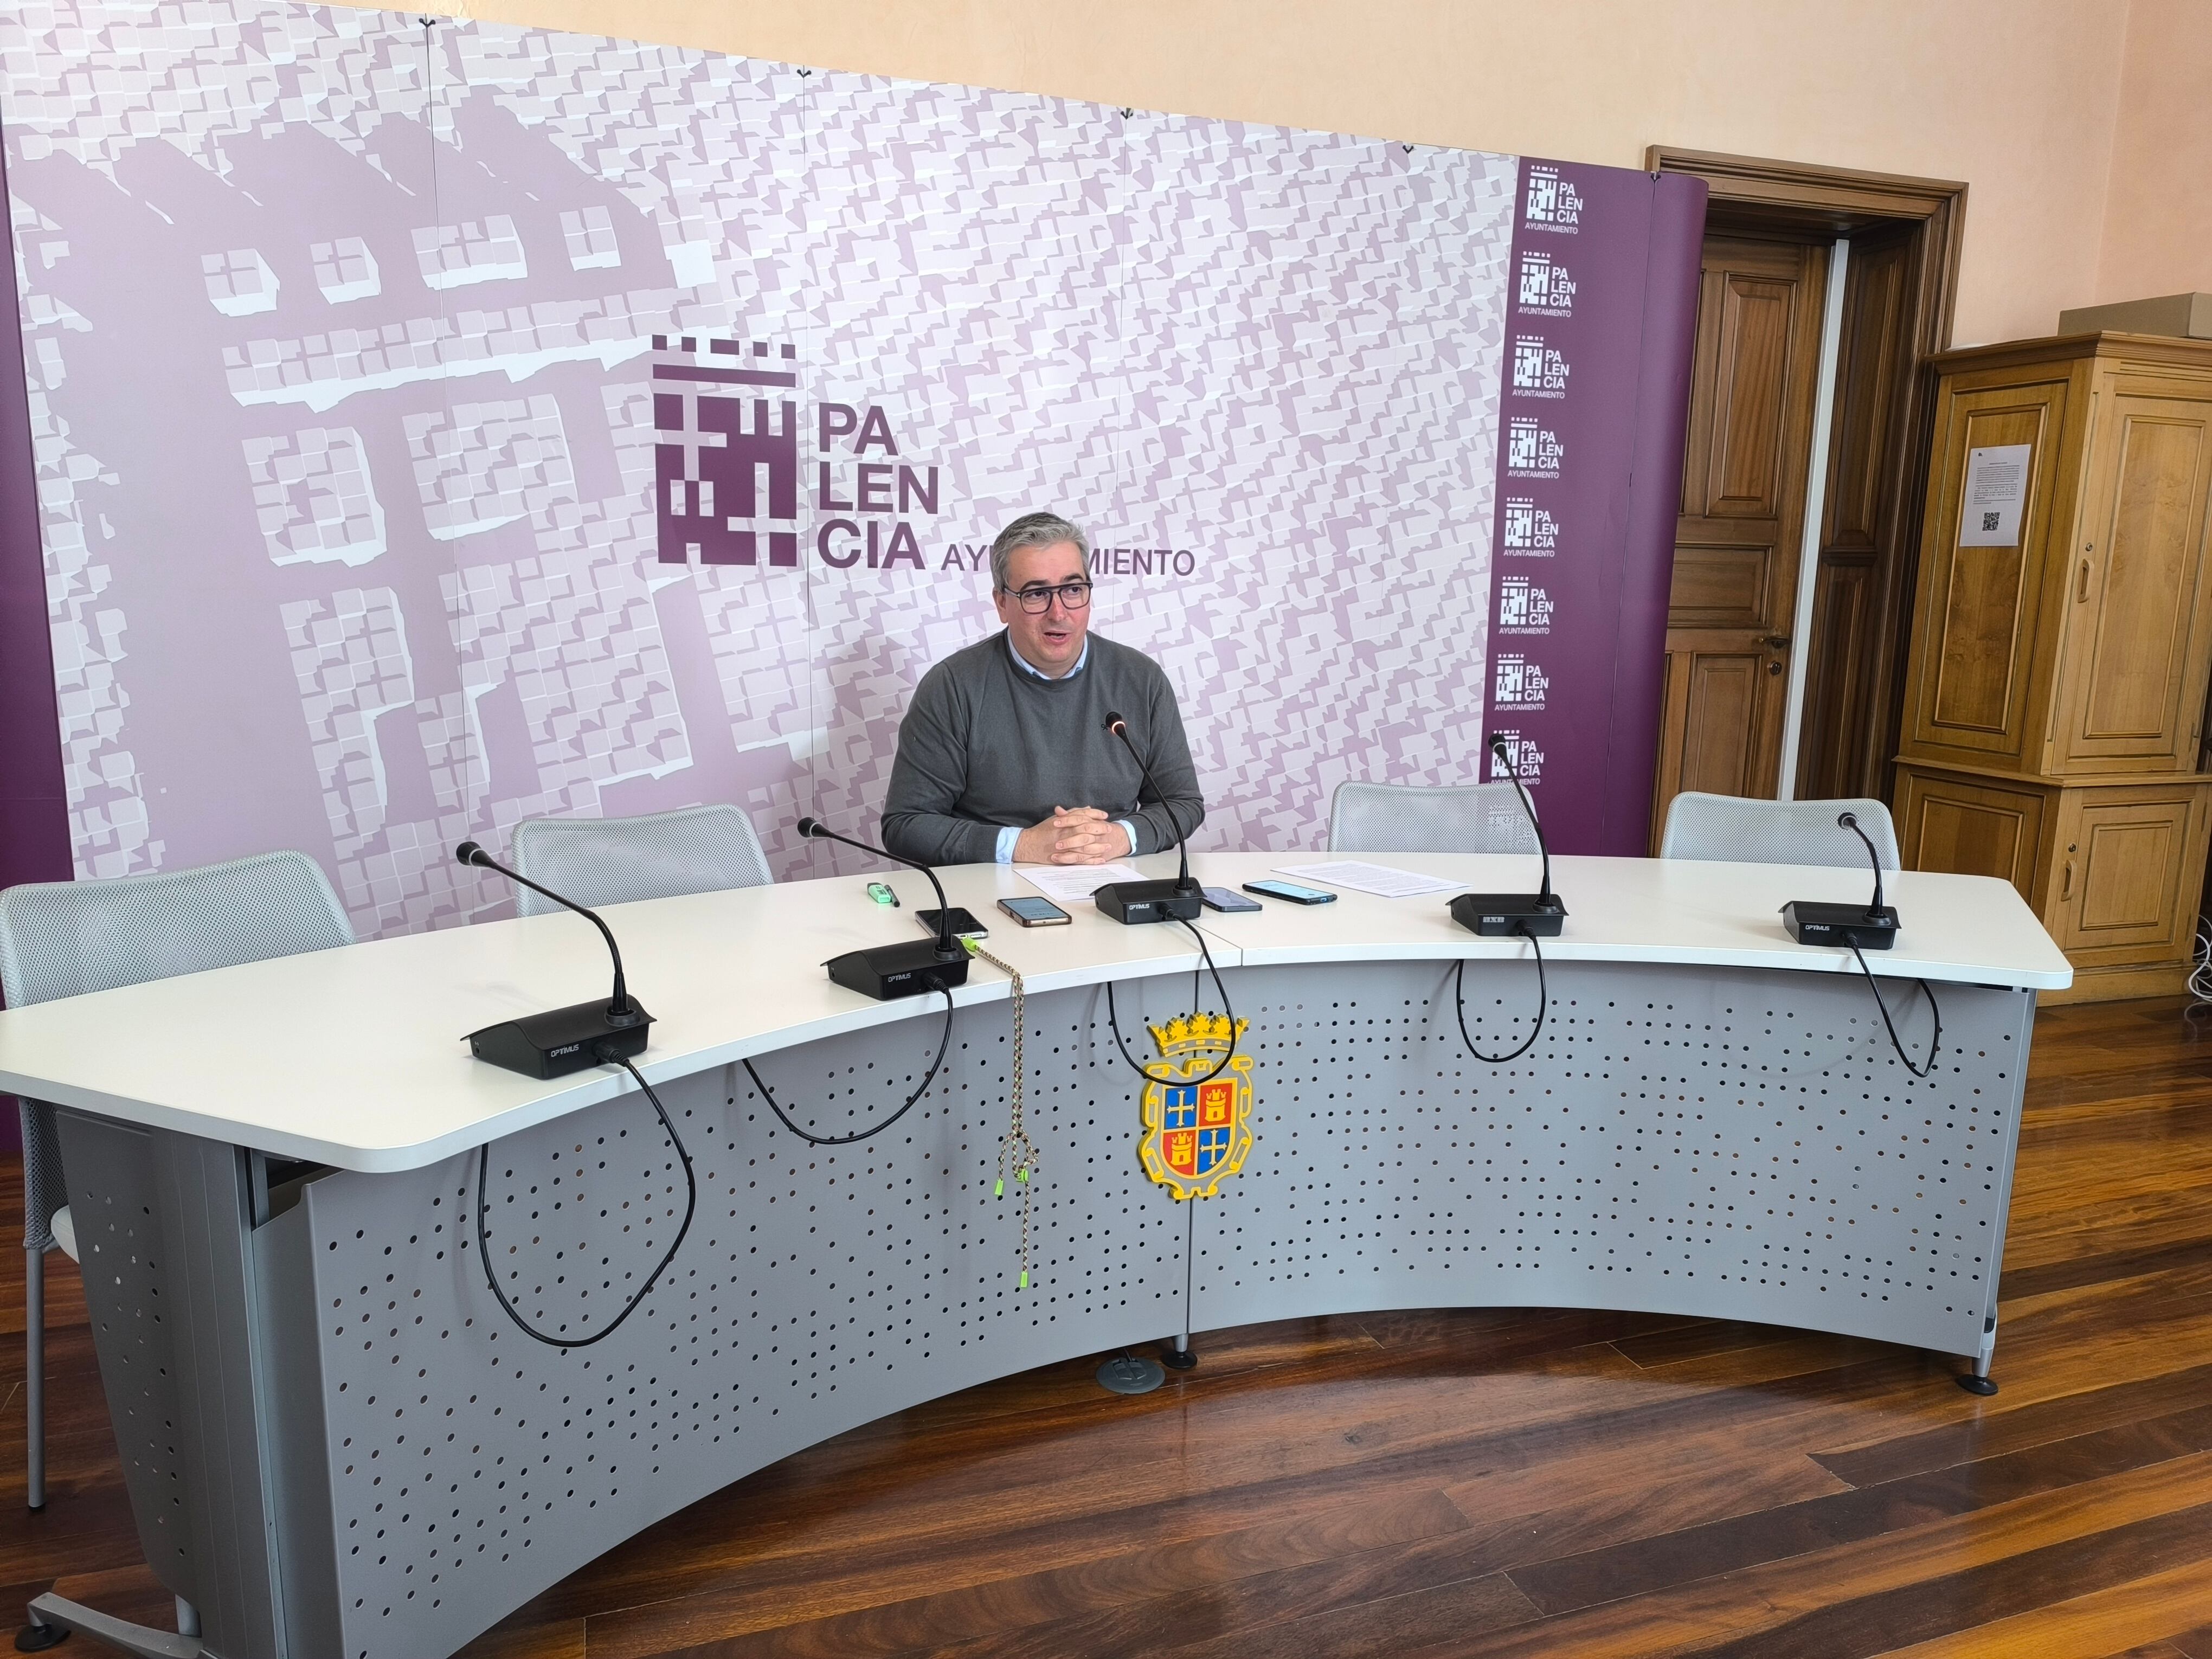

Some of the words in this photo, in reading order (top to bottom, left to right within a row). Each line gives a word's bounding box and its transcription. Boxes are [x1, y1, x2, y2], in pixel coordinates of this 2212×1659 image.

[1559, 182, 1575, 196] PA
[1558, 196, 1583, 210] LEN
[1557, 209, 1578, 224] CIA
[1525, 222, 1578, 235] AYUNTAMIENTO
[1552, 266, 1568, 280] PA
[1551, 280, 1576, 294] LEN
[1549, 293, 1571, 307] CIA
[1518, 306, 1572, 318] AYUNTAMIENTO
[1546, 350, 1561, 362] PA
[1545, 362, 1569, 376] LEN
[1543, 376, 1565, 389] CIA
[1512, 389, 1565, 399] AYUNTAMIENTO
[819, 402, 899, 456] PA
[1540, 430, 1555, 443] PA
[1539, 443, 1563, 456] LEN
[1538, 456, 1559, 469] CIA
[1507, 470, 1559, 479] AYUNTAMIENTO
[819, 461, 938, 515] LEN
[1535, 510, 1551, 522] PA
[1534, 523, 1558, 536] LEN
[817, 518, 925, 570] CIA
[1533, 535, 1554, 548] CIA
[1503, 549, 1555, 557] AYUNTAMIENTO
[1531, 588, 1546, 600] PA
[1530, 601, 1553, 613] LEN
[1528, 613, 1549, 625] CIA
[1526, 665, 1541, 677] PA
[1525, 677, 1548, 689] LEN
[1524, 690, 1545, 701] CIA
[1521, 741, 1537, 752] PA
[1521, 753, 1544, 764] LEN
[1520, 764, 1540, 776] CIA
[888, 973, 911, 982] OPTIMUS
[551, 1044, 579, 1057] OPTIMUS
